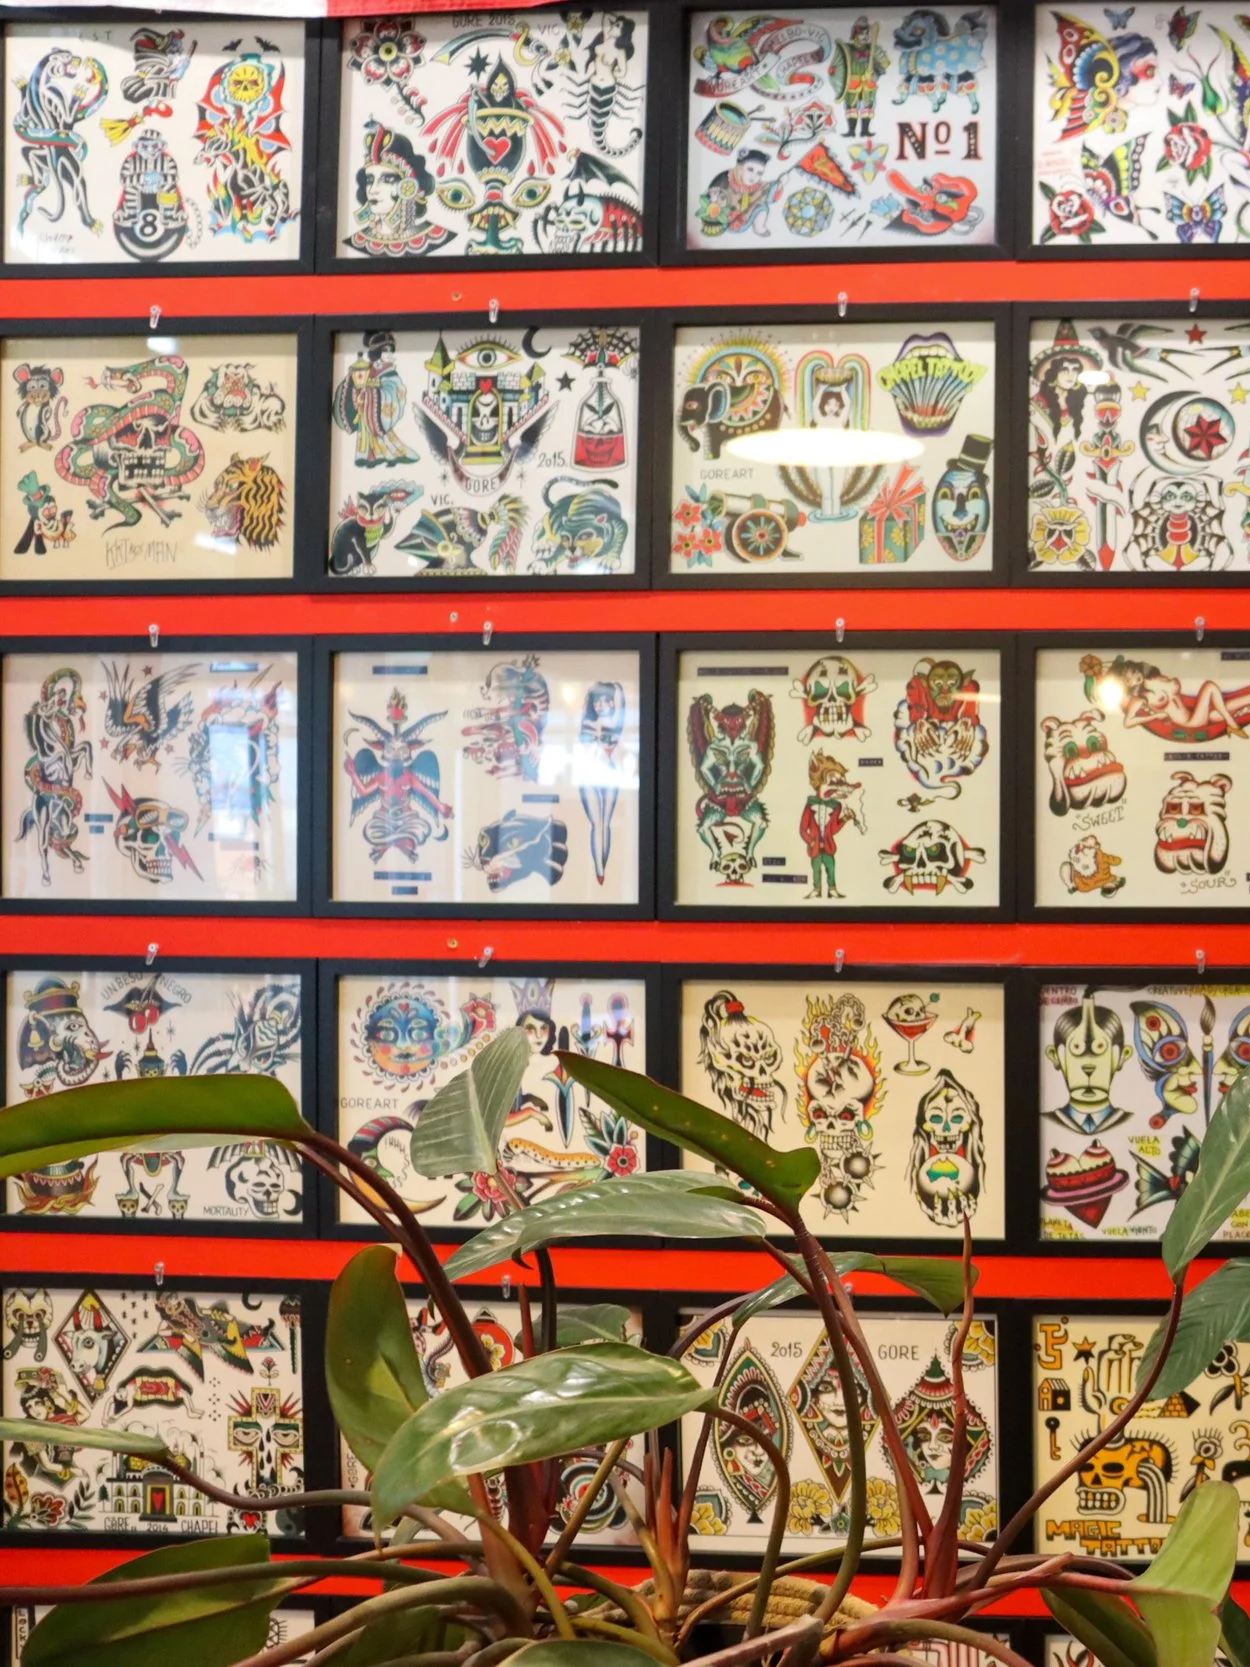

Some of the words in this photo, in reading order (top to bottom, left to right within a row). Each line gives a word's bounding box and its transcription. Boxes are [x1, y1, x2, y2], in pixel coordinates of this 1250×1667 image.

[141, 213, 157, 236] 8
[159, 975, 193, 1005] NEGRO
[1128, 1135, 1160, 1145] VUELA
[770, 1341, 803, 1359] 2015
[878, 1344, 921, 1362] GORE
[1045, 1519, 1122, 1542] MAGIC
[1079, 1537, 1167, 1558] TATTO
